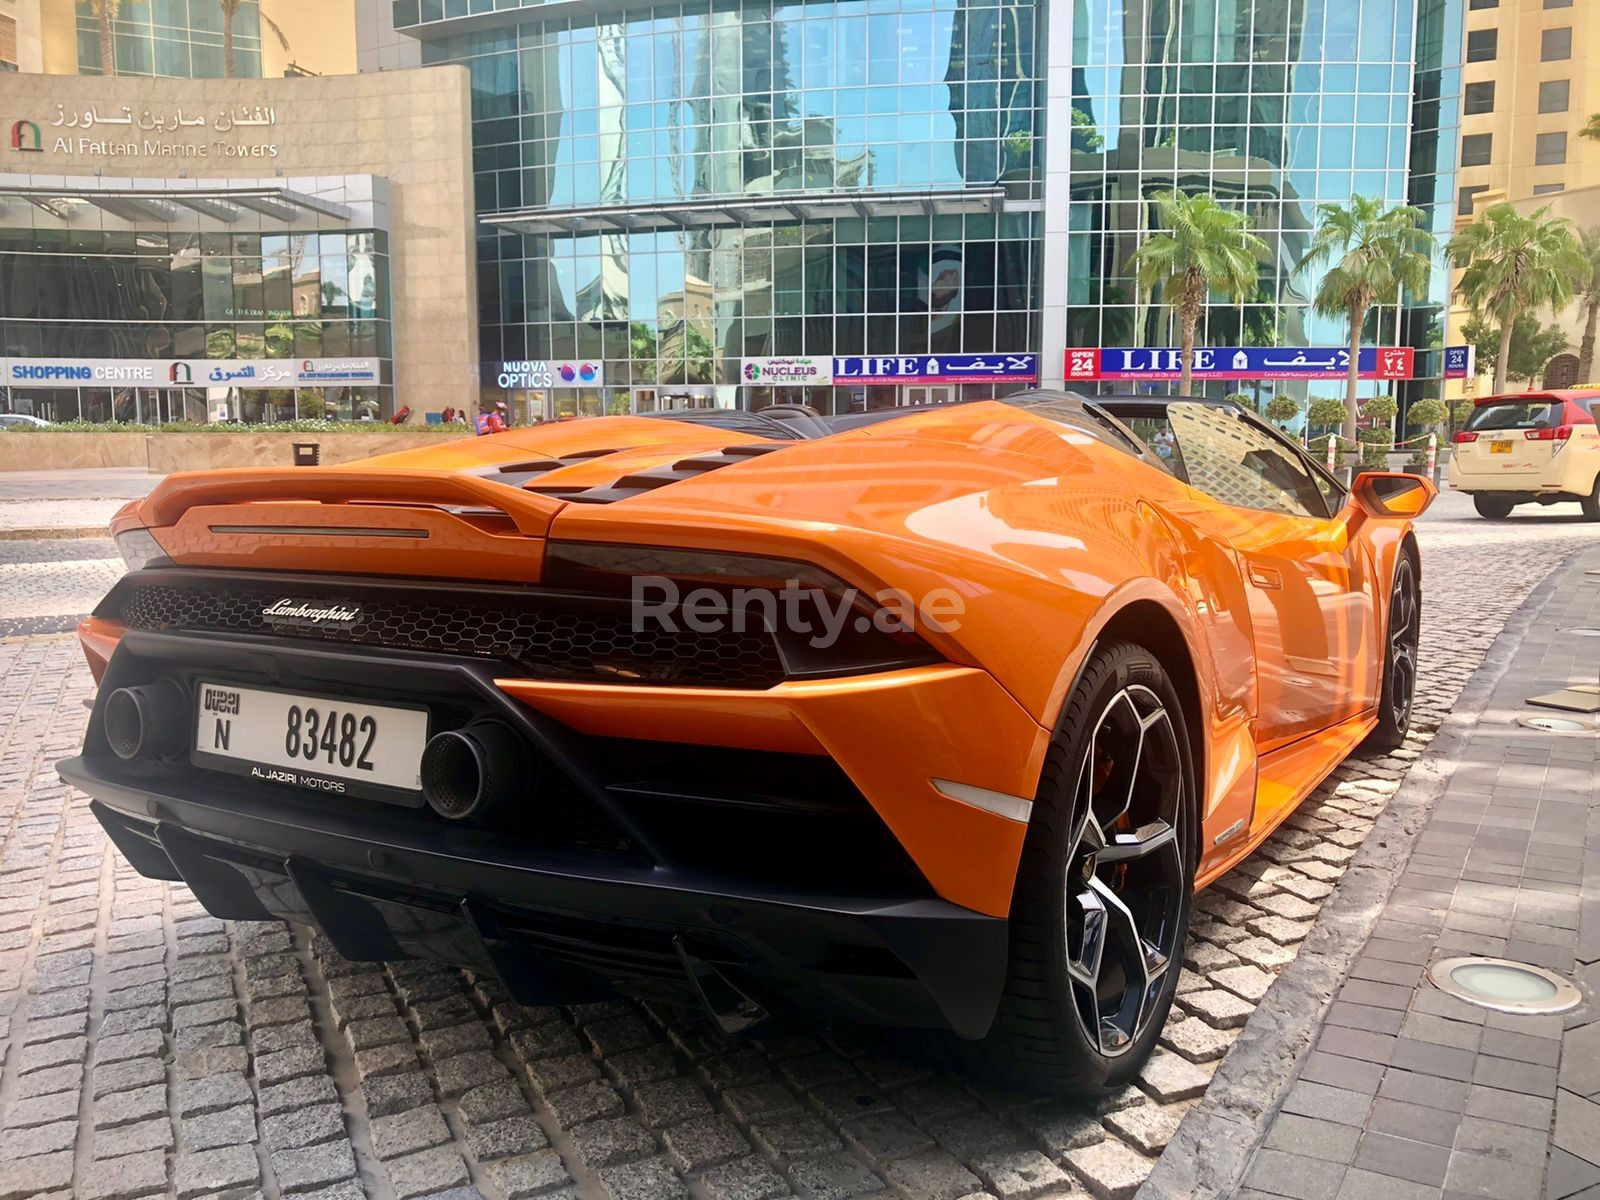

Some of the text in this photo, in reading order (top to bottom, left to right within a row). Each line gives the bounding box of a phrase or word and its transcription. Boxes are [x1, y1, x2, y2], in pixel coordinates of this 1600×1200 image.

[50, 103, 276, 134] الفتان مارين تاورز
[53, 137, 279, 158] Al Fattan Marine Towers
[503, 361, 548, 373] NUOVA
[836, 357, 919, 376] LIFE
[945, 356, 1034, 373] لايف
[1071, 358, 1094, 371] 24
[1121, 350, 1215, 370] LIFE
[1450, 355, 1462, 363] 24
[12, 364, 92, 380] SHOPPING
[94, 366, 153, 380] CENTRE
[208, 365, 291, 382] مركز التسوق
[762, 367, 817, 376] NUCLEUS
[498, 373, 553, 388] OPTICS
[262, 599, 360, 623] Lamborghini
[214, 705, 377, 771] N 83482
[251, 767, 346, 792] AL JAZIRI MOTORS
